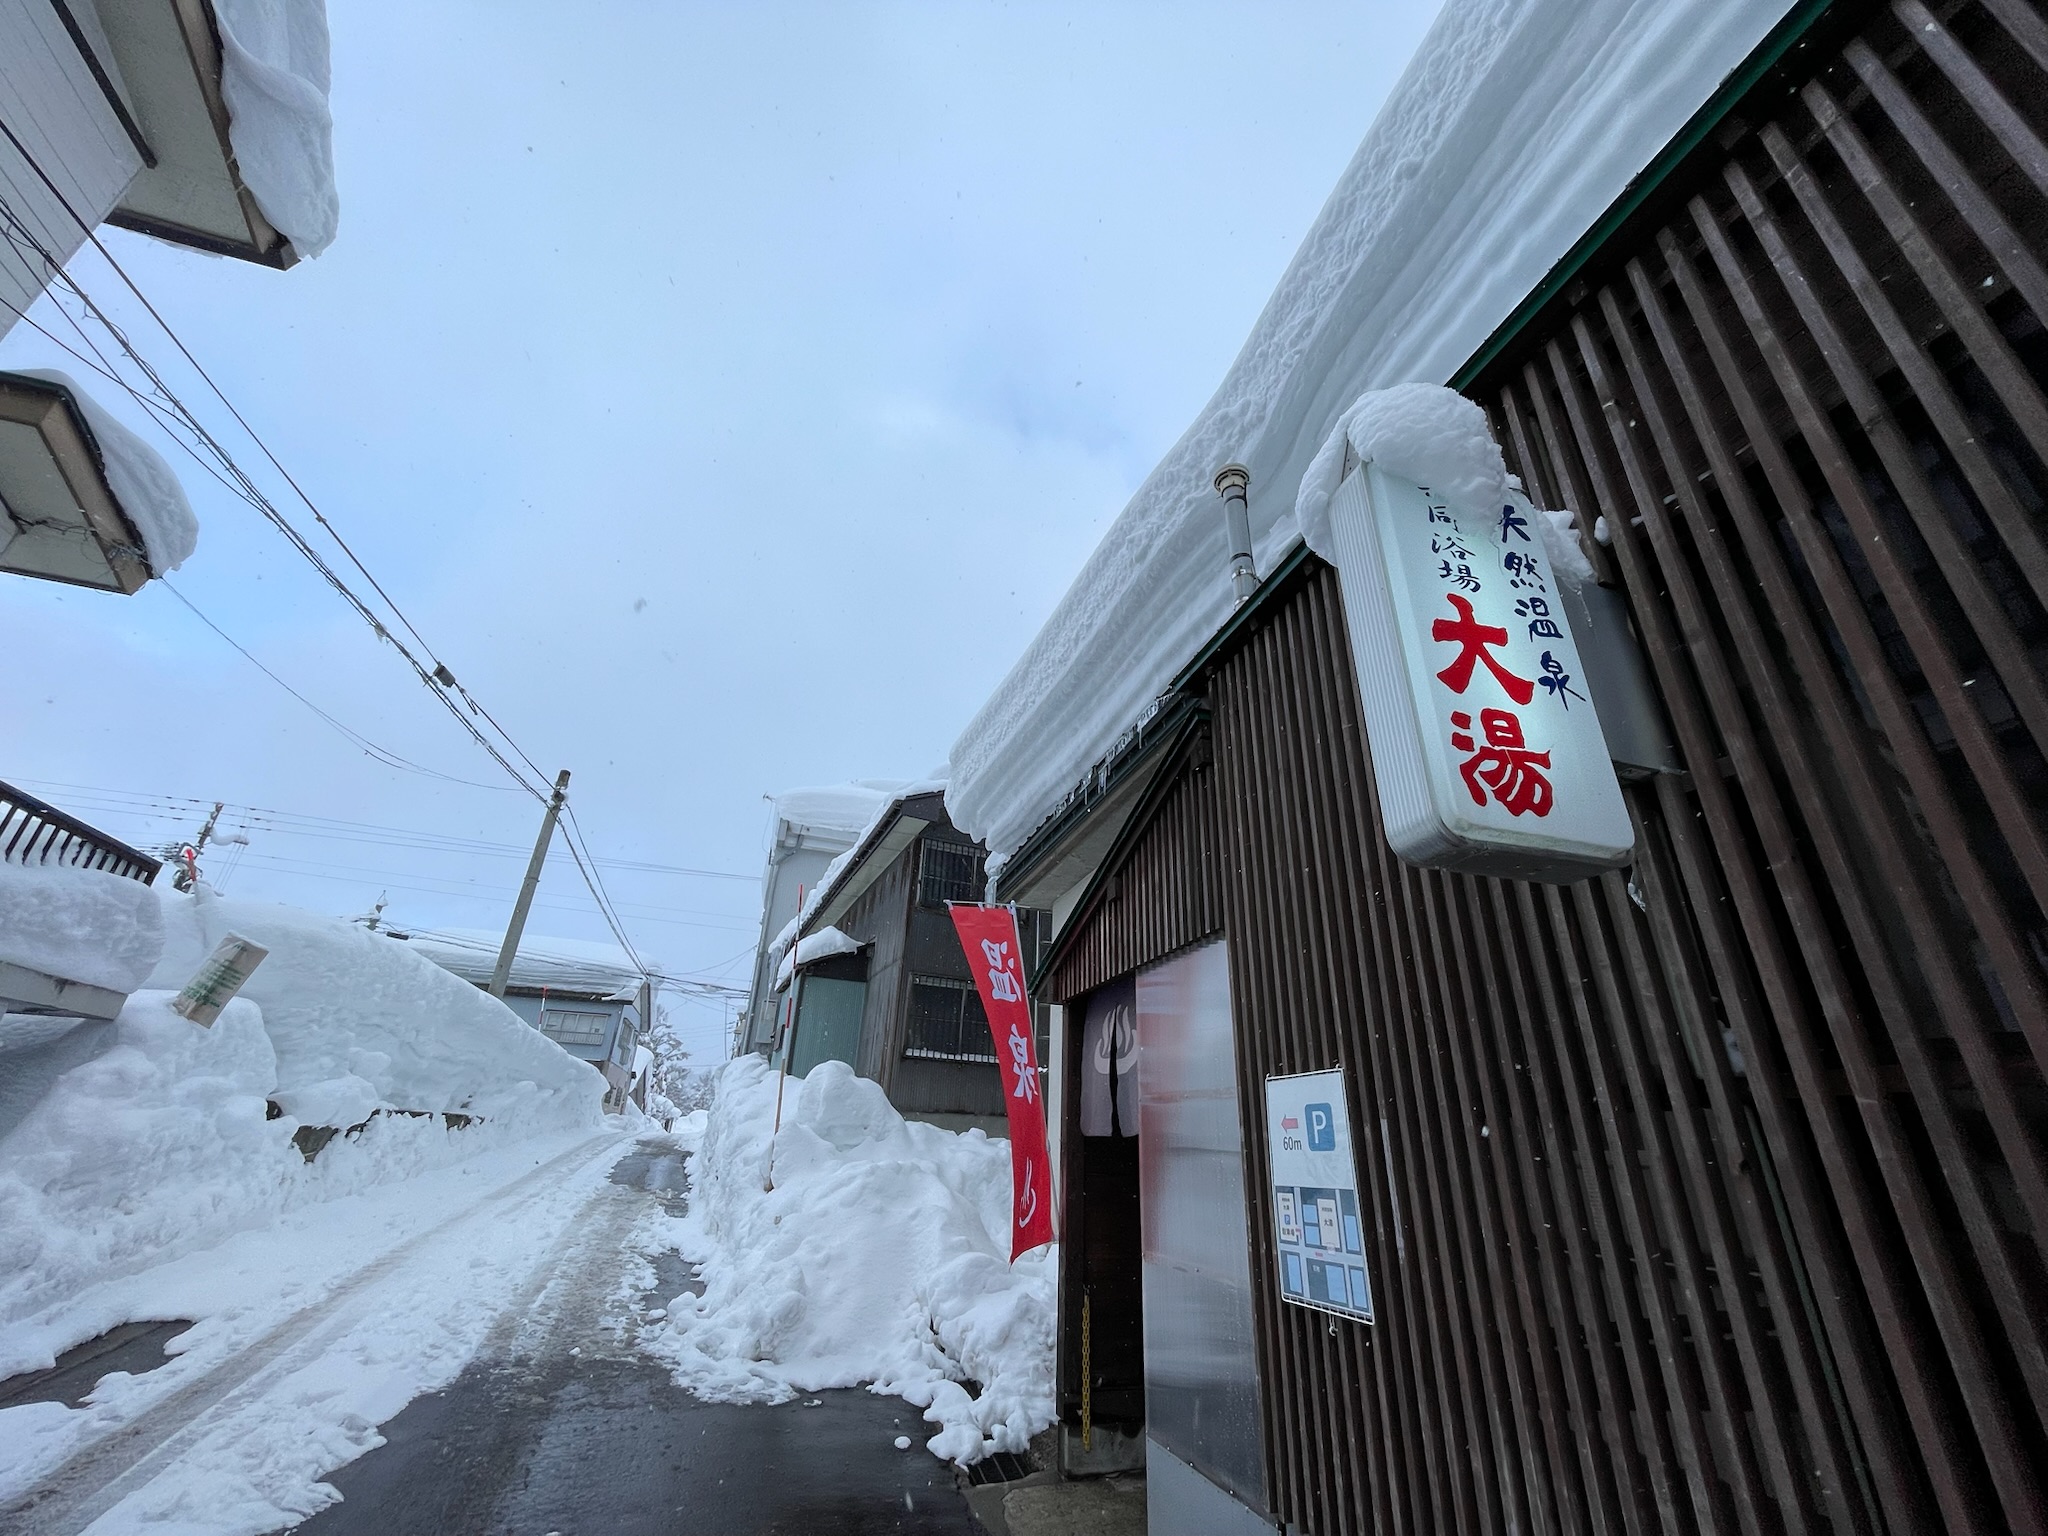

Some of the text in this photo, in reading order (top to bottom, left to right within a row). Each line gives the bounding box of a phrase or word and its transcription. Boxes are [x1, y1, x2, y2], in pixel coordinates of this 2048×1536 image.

[1417, 485, 1482, 593] 同浴場
[1498, 504, 1587, 711] 天然温泉
[1432, 592, 1553, 818] 大湯
[1283, 1136, 1302, 1151] 60m
[1311, 1110, 1327, 1144] P
